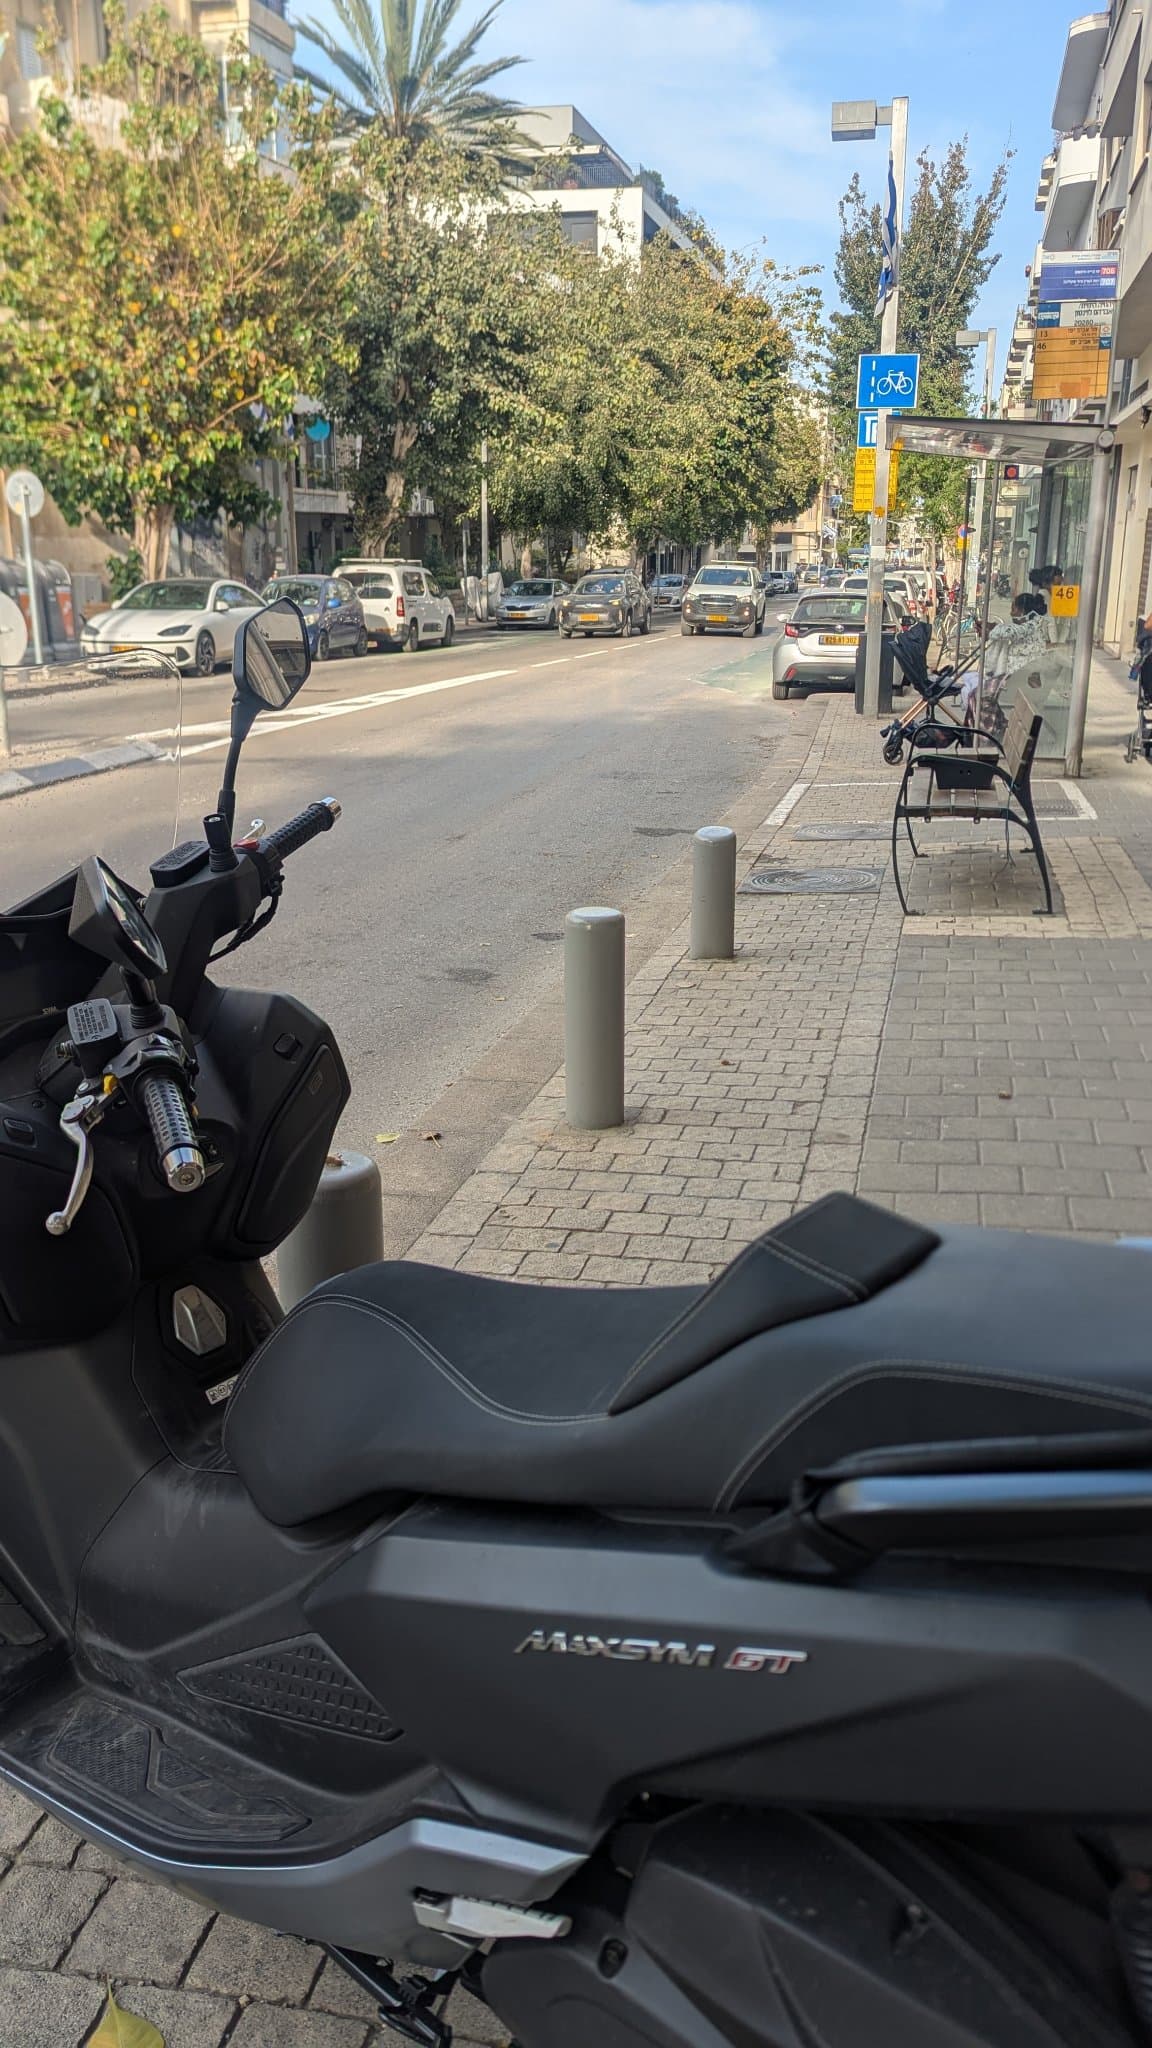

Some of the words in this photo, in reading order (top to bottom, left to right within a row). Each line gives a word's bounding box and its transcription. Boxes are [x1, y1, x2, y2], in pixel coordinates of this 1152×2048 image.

[1056, 587, 1074, 600] 46
[513, 1629, 716, 1667] MAXSYM
[722, 1645, 808, 1675] GT
